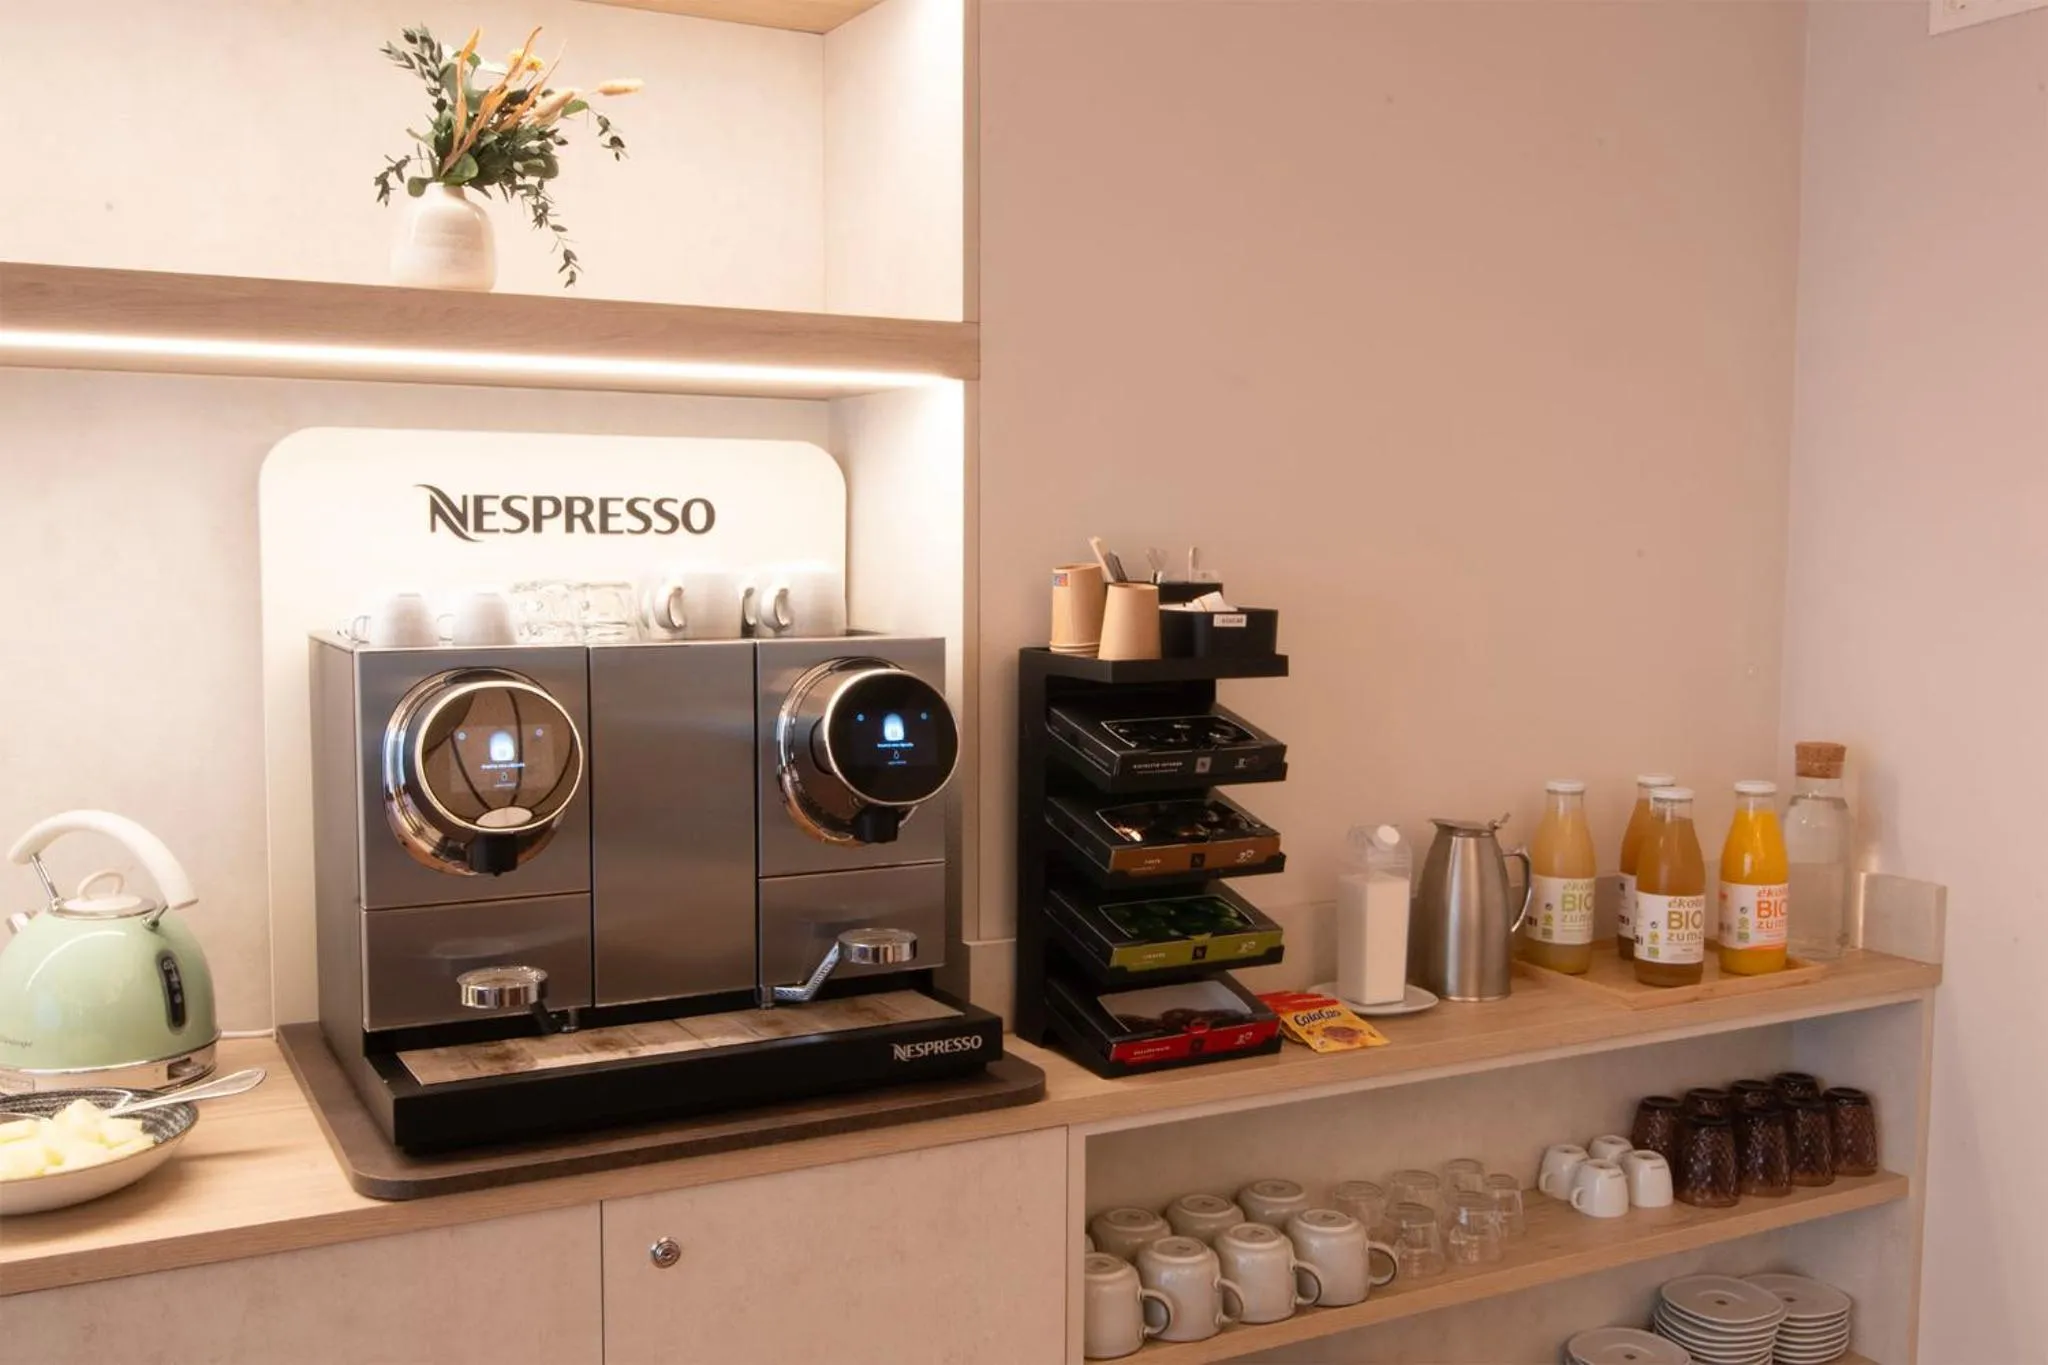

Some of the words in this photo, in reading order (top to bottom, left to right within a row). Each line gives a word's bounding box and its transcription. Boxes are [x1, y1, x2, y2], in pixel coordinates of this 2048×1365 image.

[413, 484, 716, 542] NESPRESSO
[1668, 910, 1704, 930] BIO
[890, 1035, 983, 1061] NESPRESSO
